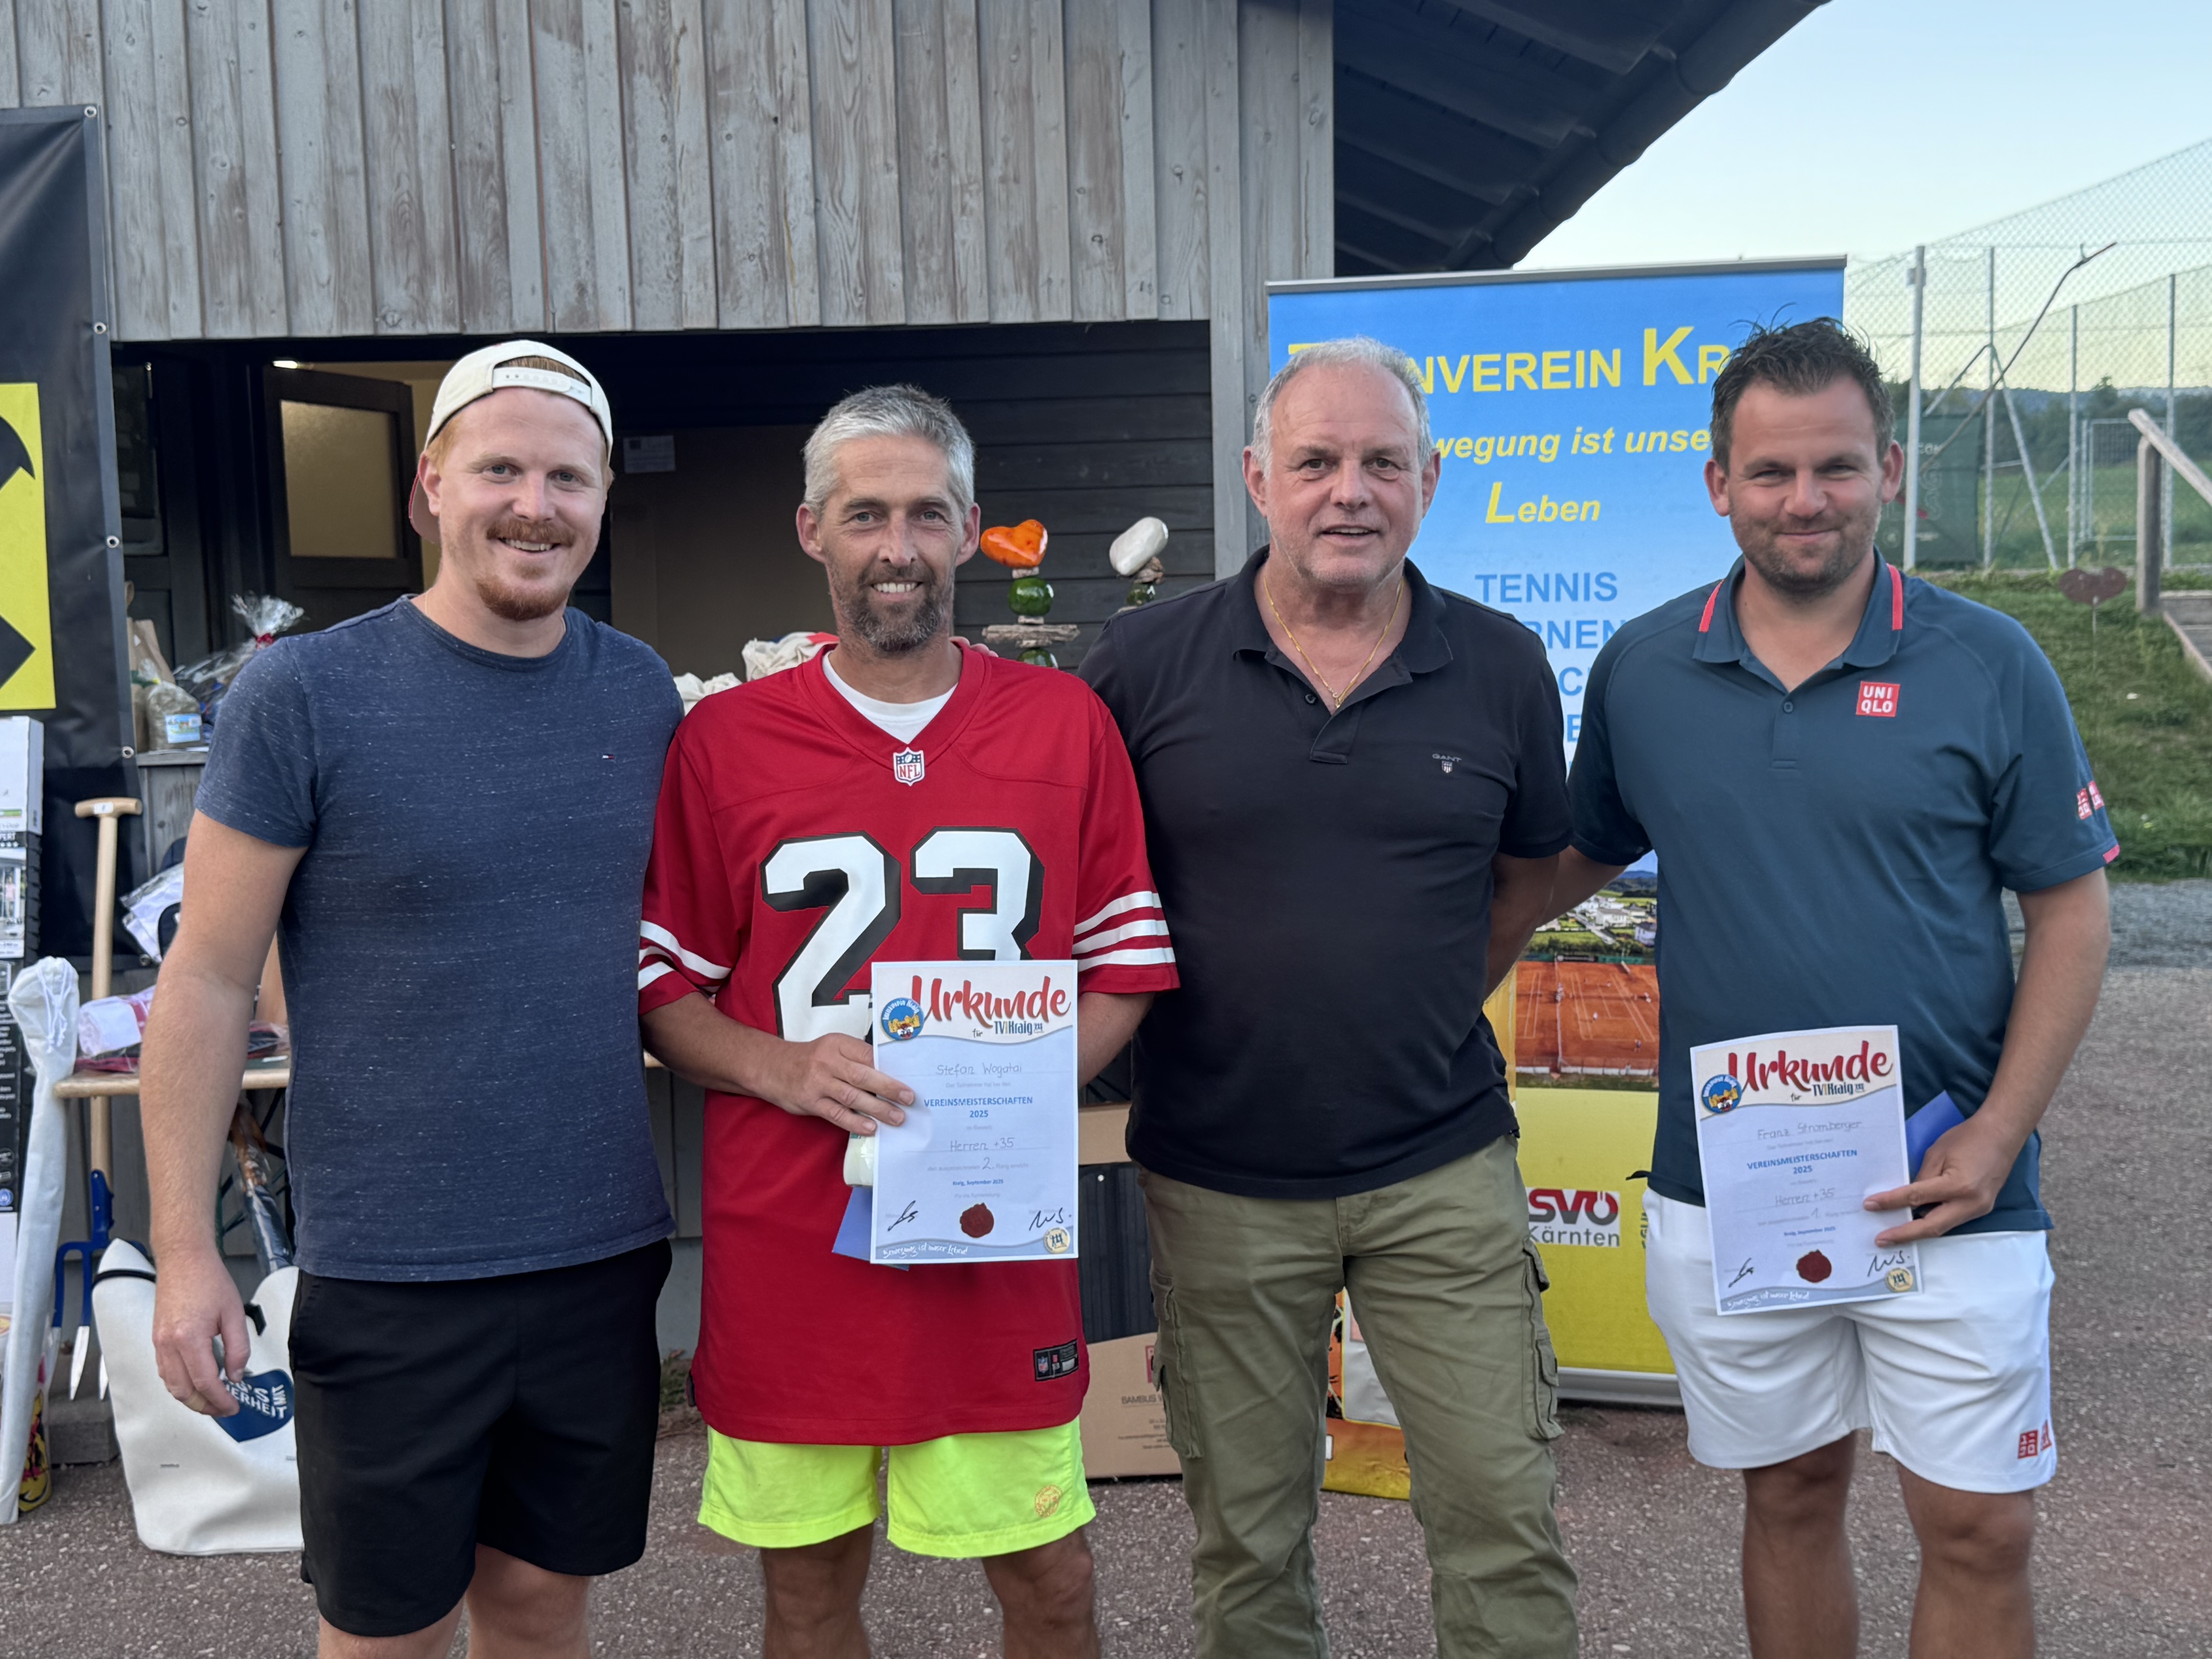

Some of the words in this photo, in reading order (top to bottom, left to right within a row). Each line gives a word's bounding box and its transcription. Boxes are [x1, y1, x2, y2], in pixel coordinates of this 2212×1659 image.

[1436, 433, 1561, 465] wegung
[1571, 426, 1614, 455] ist
[1624, 429, 1711, 453] unse
[1485, 481, 1600, 523] Leben
[1475, 572, 1618, 603] TENNIS
[1863, 685, 1893, 699] UNI
[1861, 699, 1892, 714] QLO
[1432, 753, 1462, 762] GANT
[899, 764, 921, 779] NFL
[759, 826, 1045, 1042] 23
[912, 975, 1071, 1029] Urkunde
[936, 1063, 975, 1078] Stefan
[1728, 1041, 1893, 1092] Urkunde
[924, 1096, 1033, 1107] VEREINSMEISTERSCHAFTEN
[1758, 1128, 1790, 1140] Franz
[950, 1140, 988, 1152] Herren
[994, 1137, 1015, 1149] +35
[1747, 1149, 1858, 1170] VEREINSMEISTERSCHAFTEN
[1793, 1165, 1813, 1174] 2025
